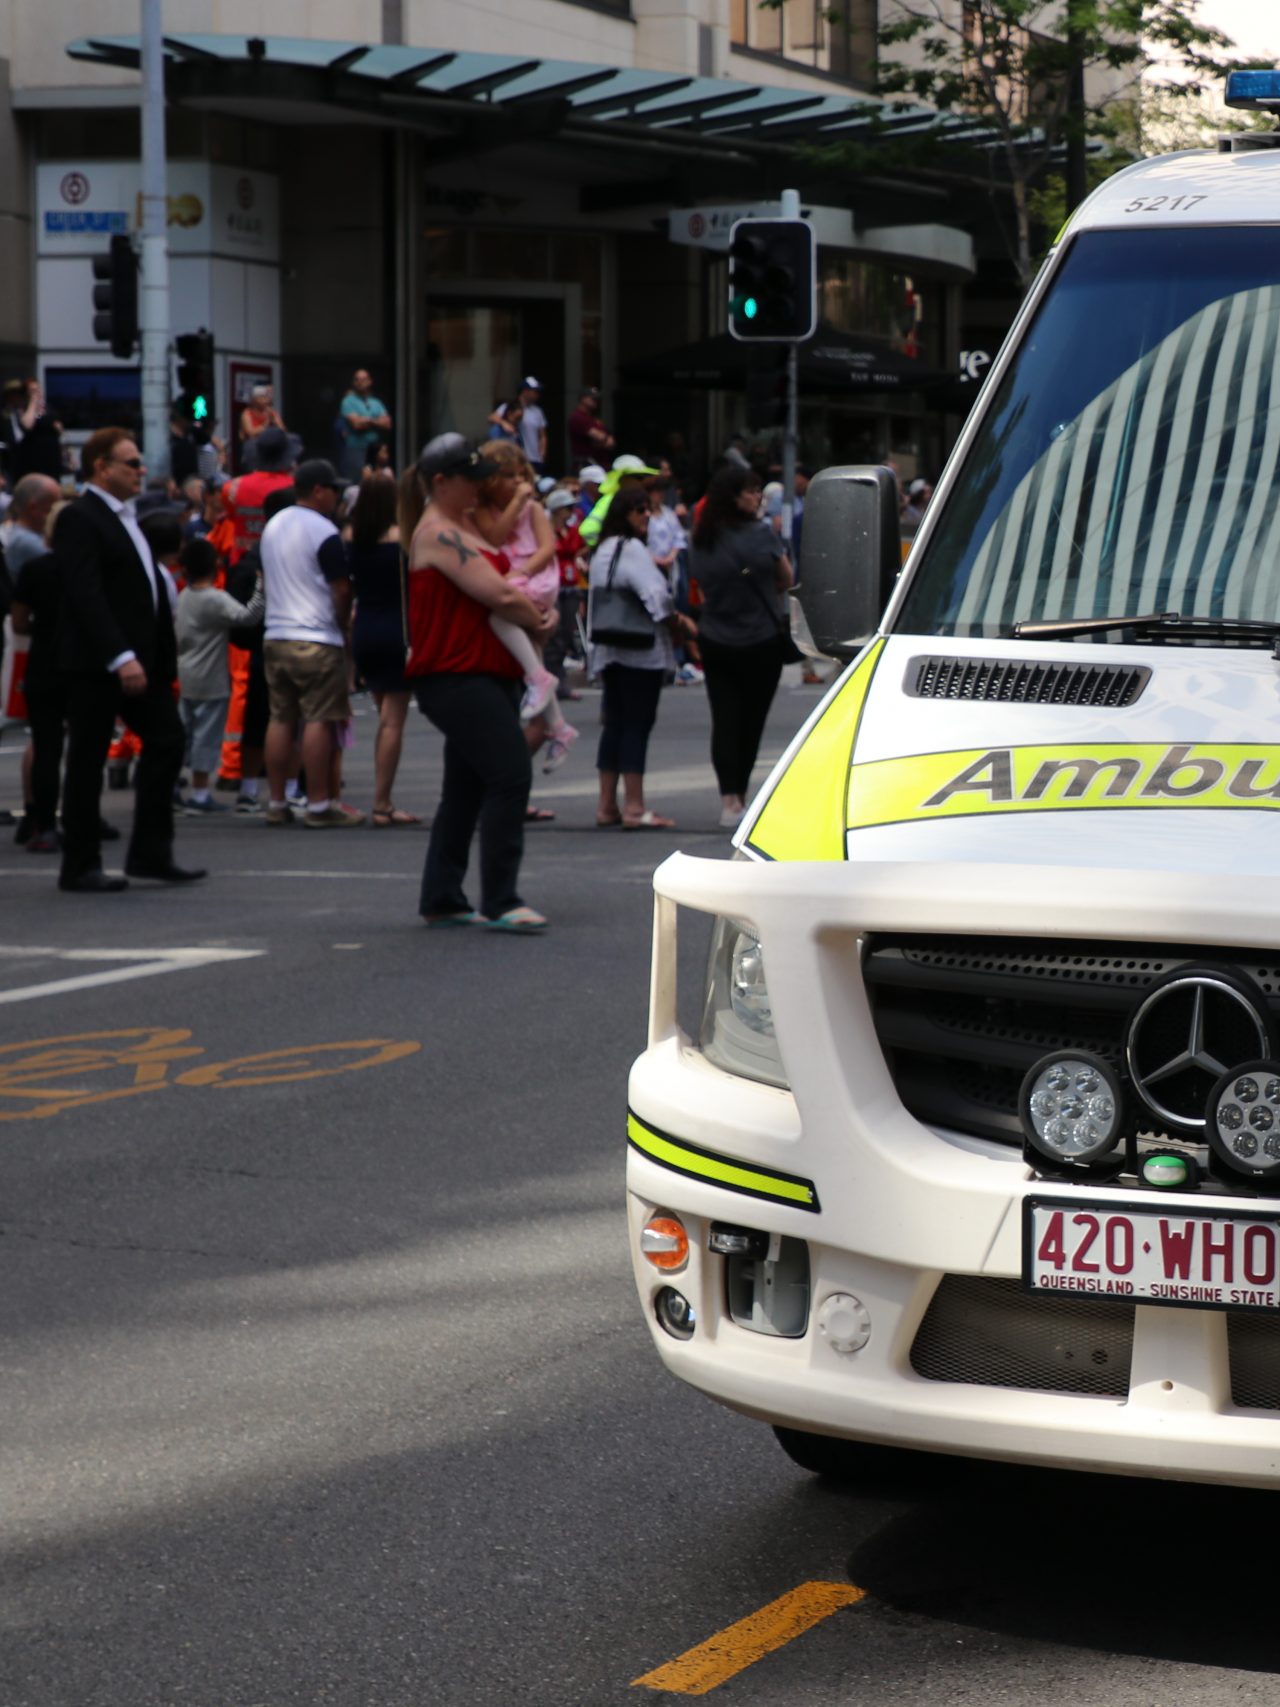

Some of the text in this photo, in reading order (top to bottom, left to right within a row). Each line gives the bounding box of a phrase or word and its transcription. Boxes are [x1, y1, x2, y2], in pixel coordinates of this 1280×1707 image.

[1124, 195, 1208, 213] 5217
[1039, 1273, 1134, 1295] QUEENSLAND
[1150, 1283, 1222, 1302] SUNSHINE
[1230, 1290, 1275, 1306] STATE
